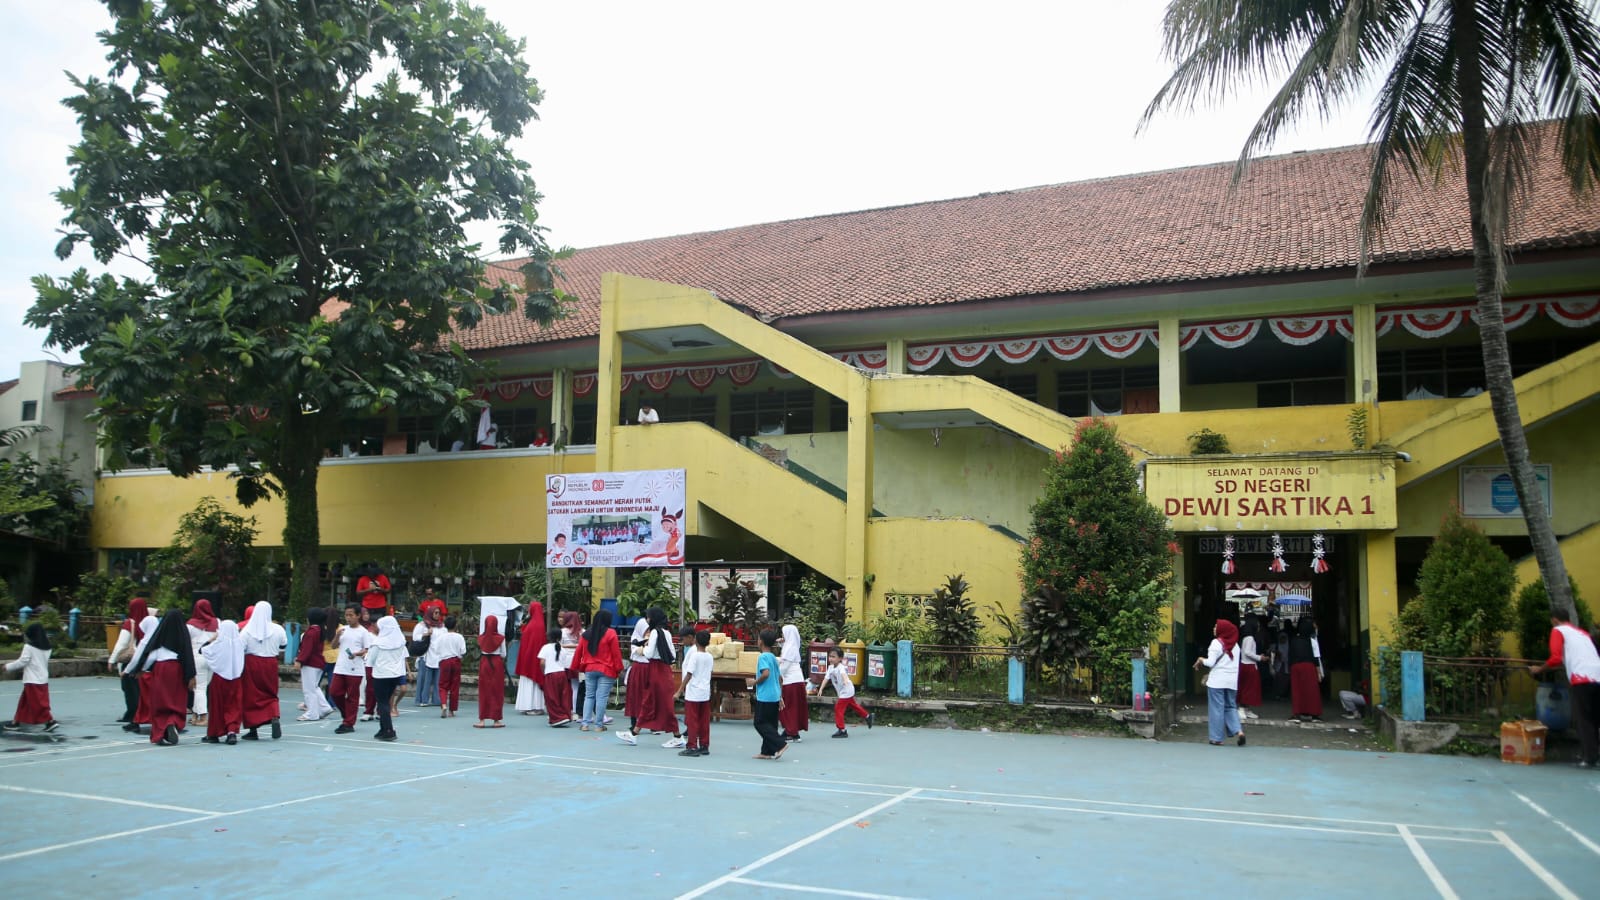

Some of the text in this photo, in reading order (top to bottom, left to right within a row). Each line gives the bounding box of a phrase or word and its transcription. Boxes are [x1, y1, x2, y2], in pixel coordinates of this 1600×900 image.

[1207, 467, 1319, 477] SELAMAT DATANG DI
[1215, 478, 1310, 494] SD NEGERI
[1165, 495, 1375, 517] DEWI SARTIKA 1
